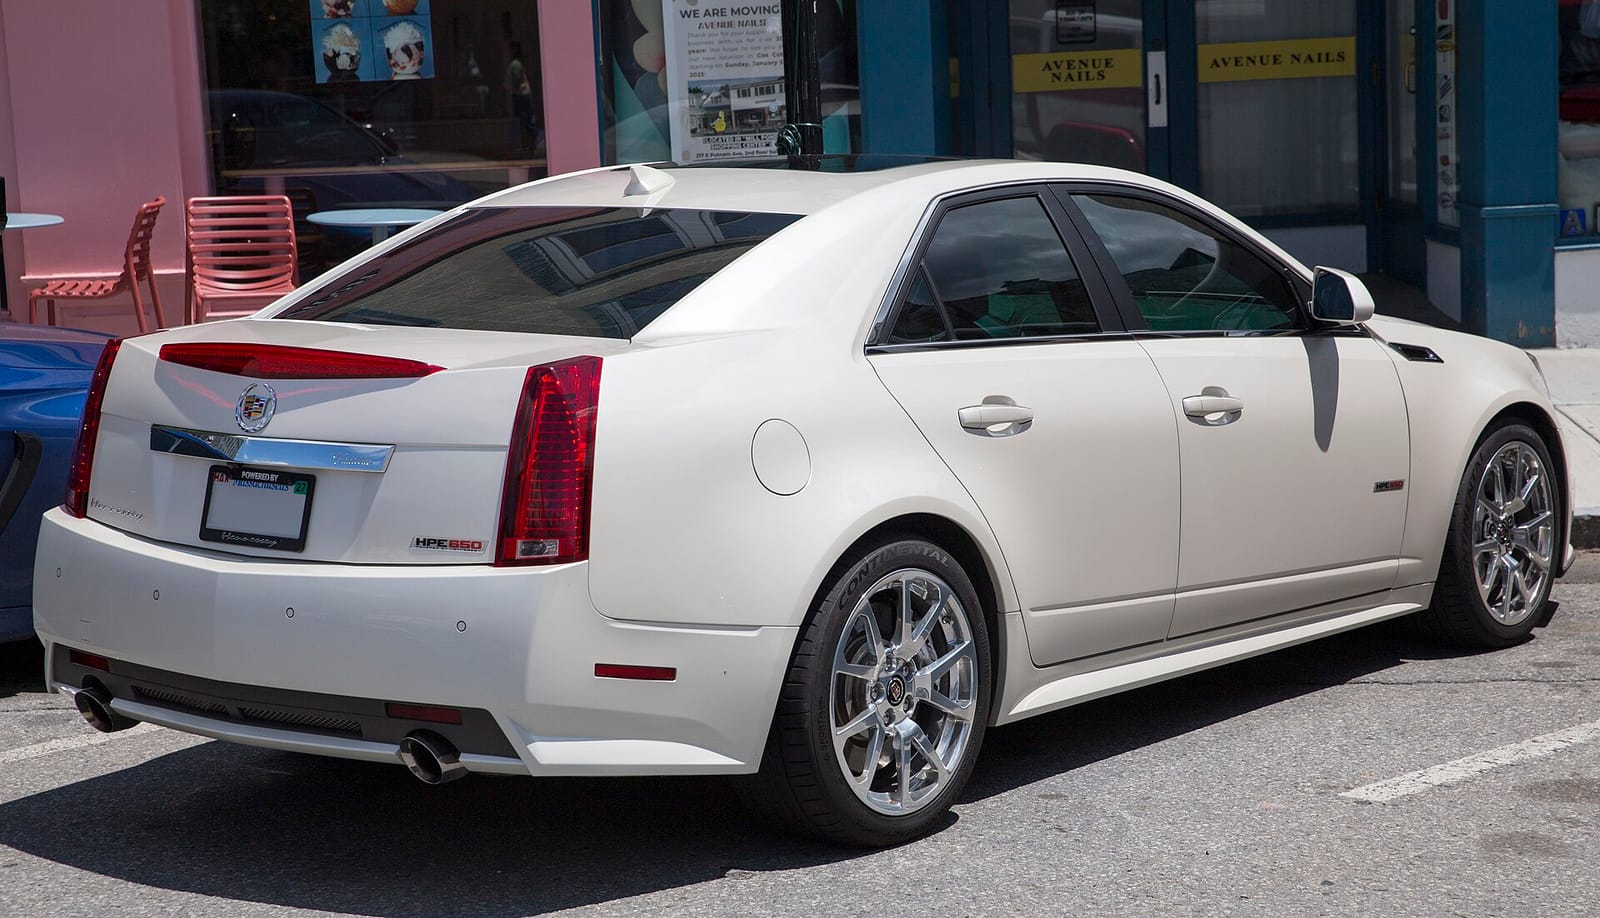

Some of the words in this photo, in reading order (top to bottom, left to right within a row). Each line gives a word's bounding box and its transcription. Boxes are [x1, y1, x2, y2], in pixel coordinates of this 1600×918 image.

[680, 9, 700, 19] WE
[703, 8, 728, 18] ARE
[731, 5, 780, 16] MOVING
[698, 21, 736, 30] AVENUE
[738, 19, 767, 28] NAILS
[1041, 58, 1115, 72] AVENUE
[1209, 54, 1283, 69] AVENUE
[1290, 51, 1346, 64] NAILS
[1051, 70, 1106, 83] NAILS
[241, 471, 270, 482] POWERED
[270, 473, 279, 482] BY
[295, 482, 307, 493] 27
[415, 537, 484, 550] HPE650
[837, 545, 950, 611] CONTINENTAL
